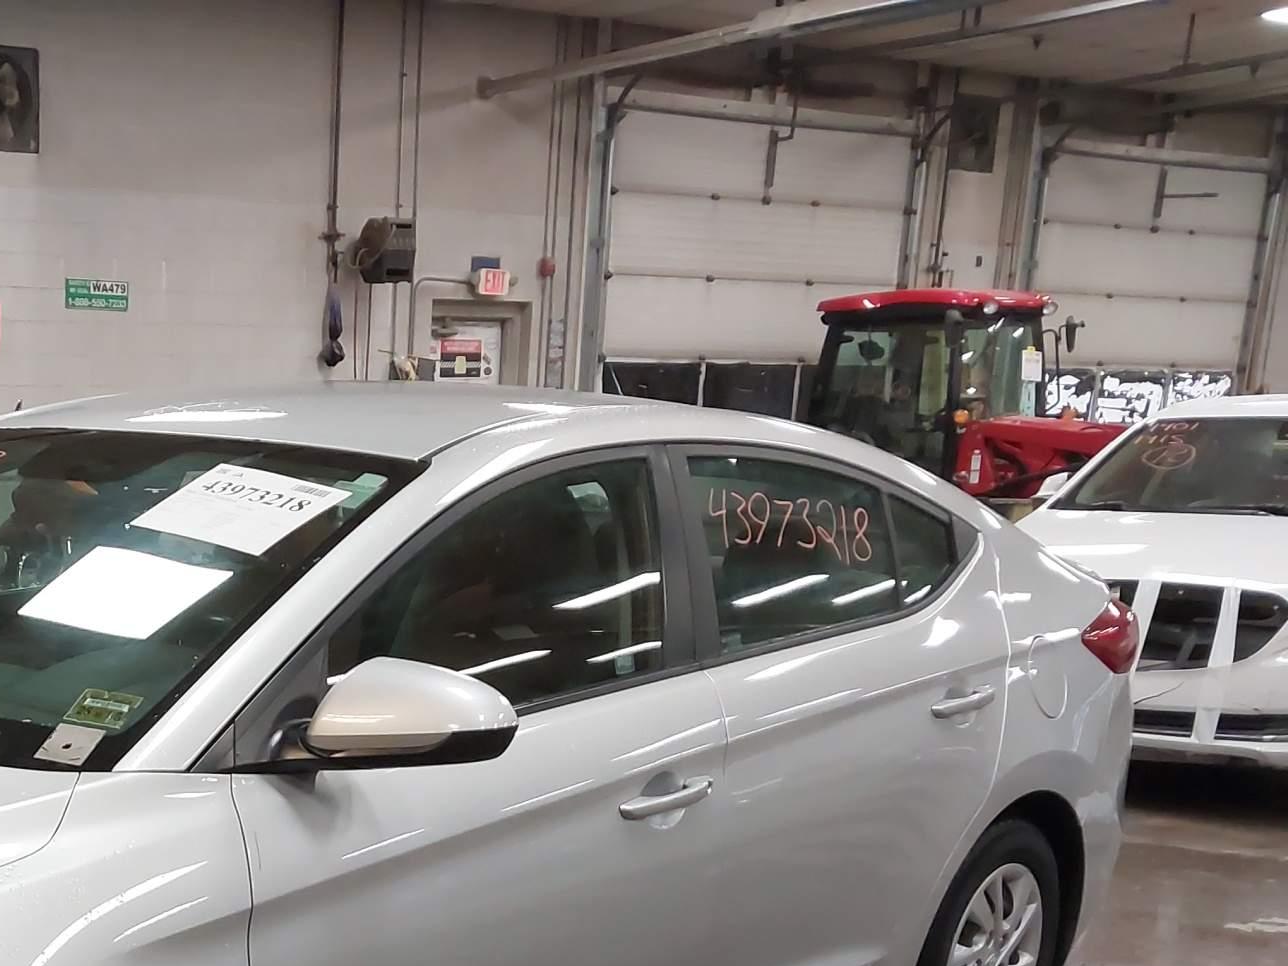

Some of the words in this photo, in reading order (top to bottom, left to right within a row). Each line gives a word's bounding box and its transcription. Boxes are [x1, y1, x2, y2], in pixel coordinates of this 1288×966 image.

[92, 282, 126, 294] WA479
[201, 480, 312, 513] 43973218
[708, 487, 873, 566] 43973218
